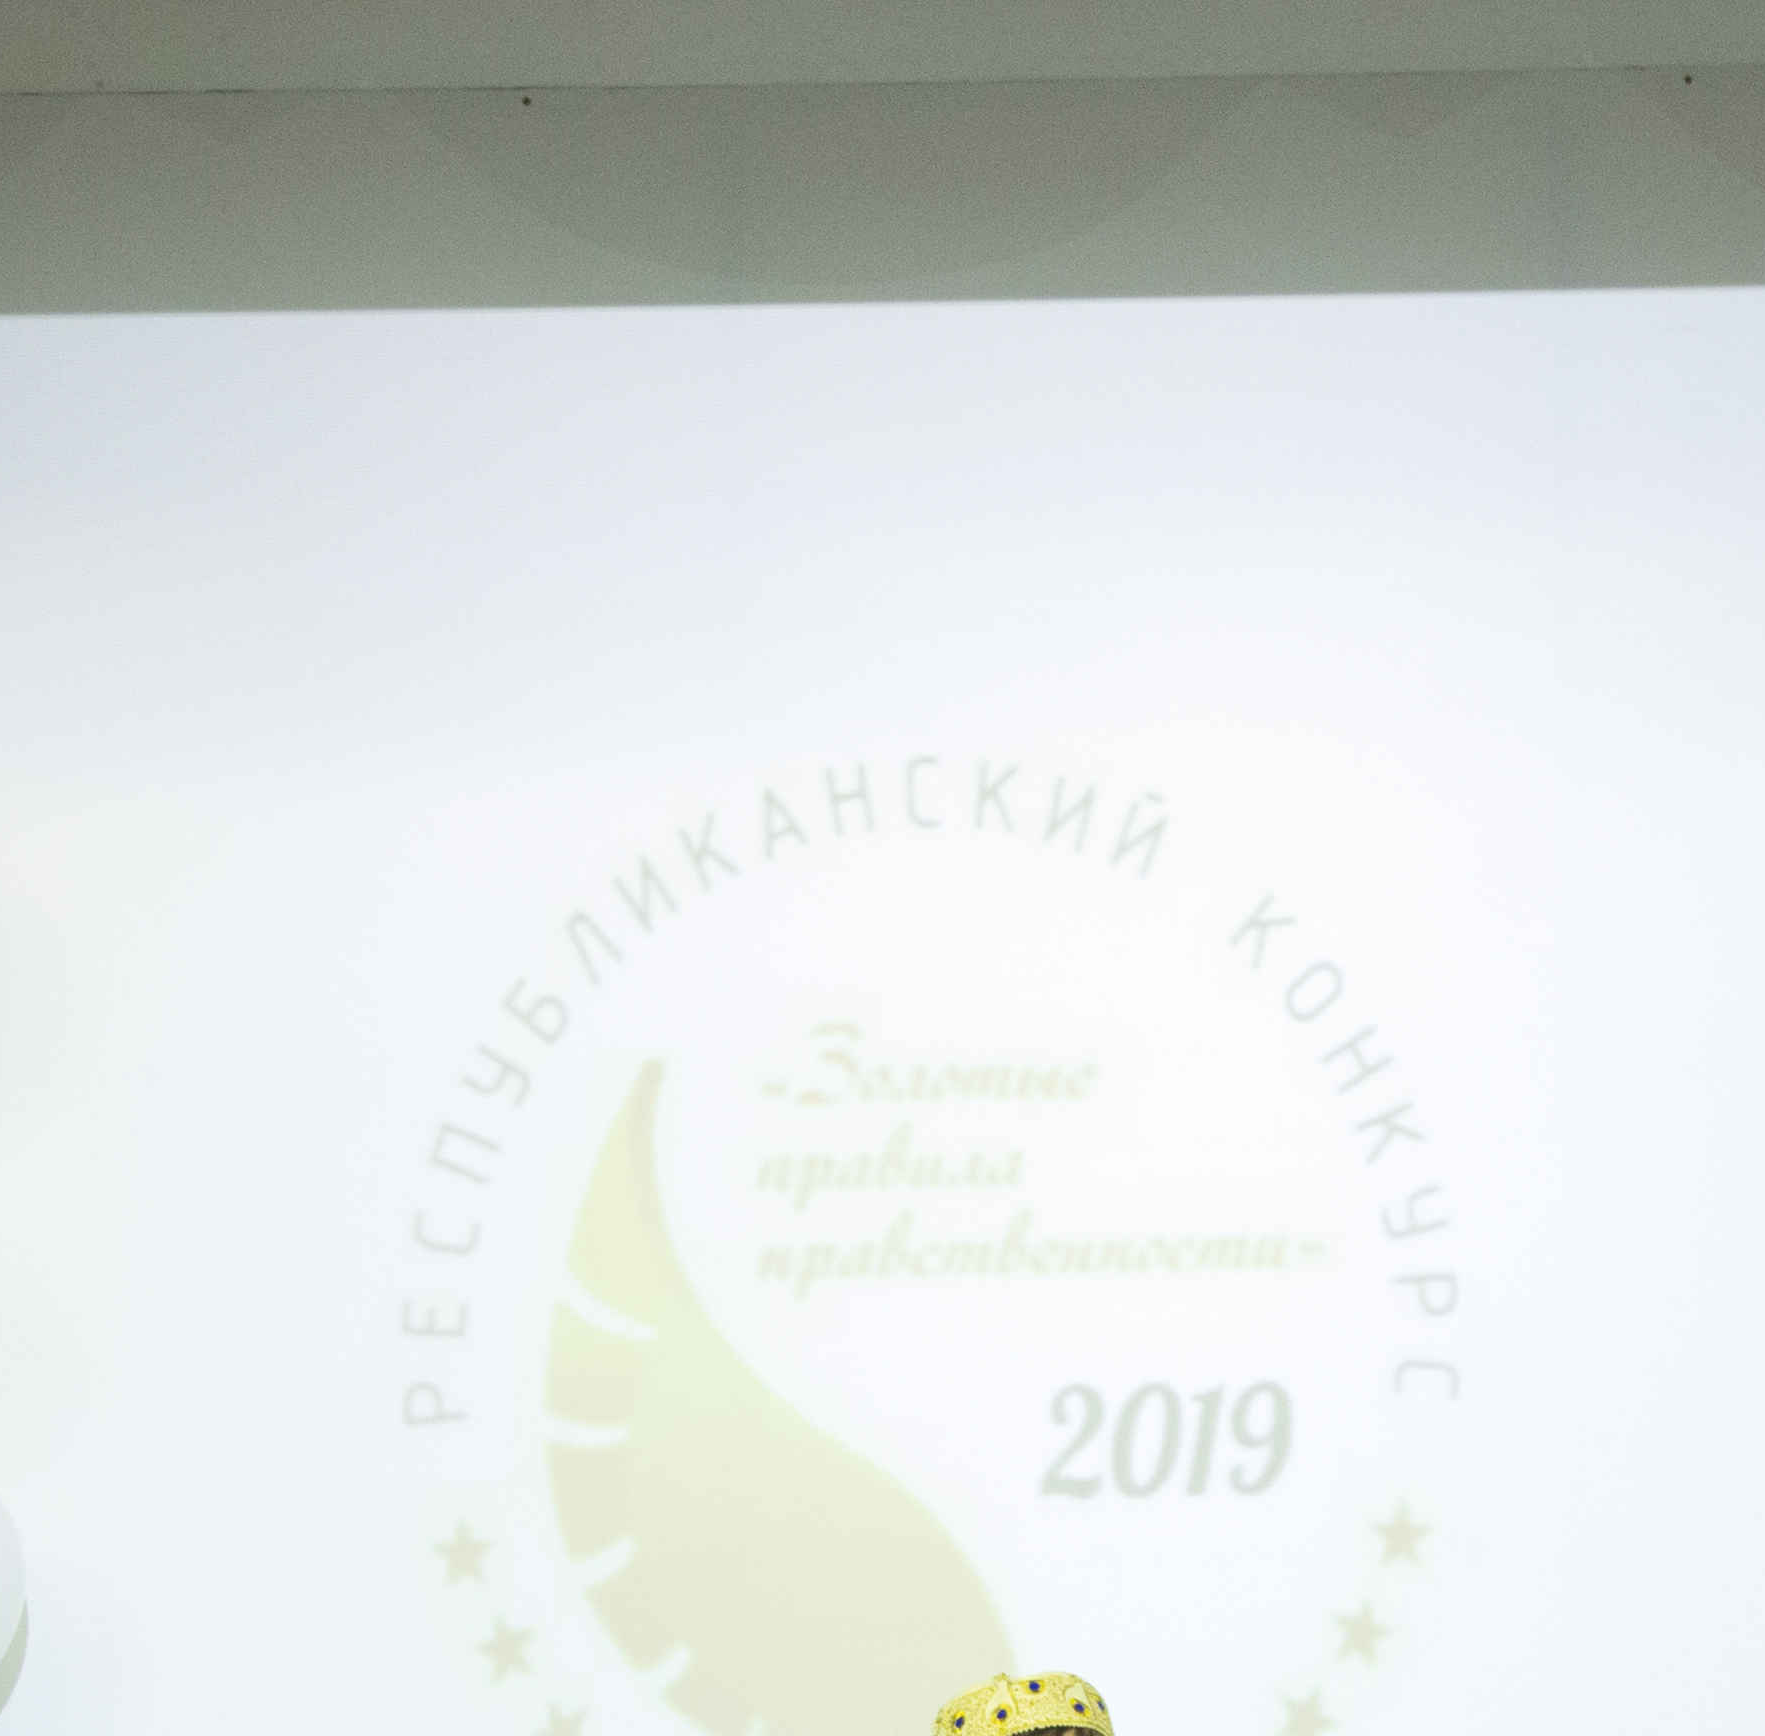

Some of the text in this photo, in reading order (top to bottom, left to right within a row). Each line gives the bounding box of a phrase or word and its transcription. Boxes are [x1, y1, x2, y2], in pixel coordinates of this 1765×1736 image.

[402, 754, 1462, 1426] РЕСПУБЛИКАНСКИЙ КОНКУРС
[755, 1118, 1026, 1214] правила
[1038, 1379, 1296, 1500] 2019
